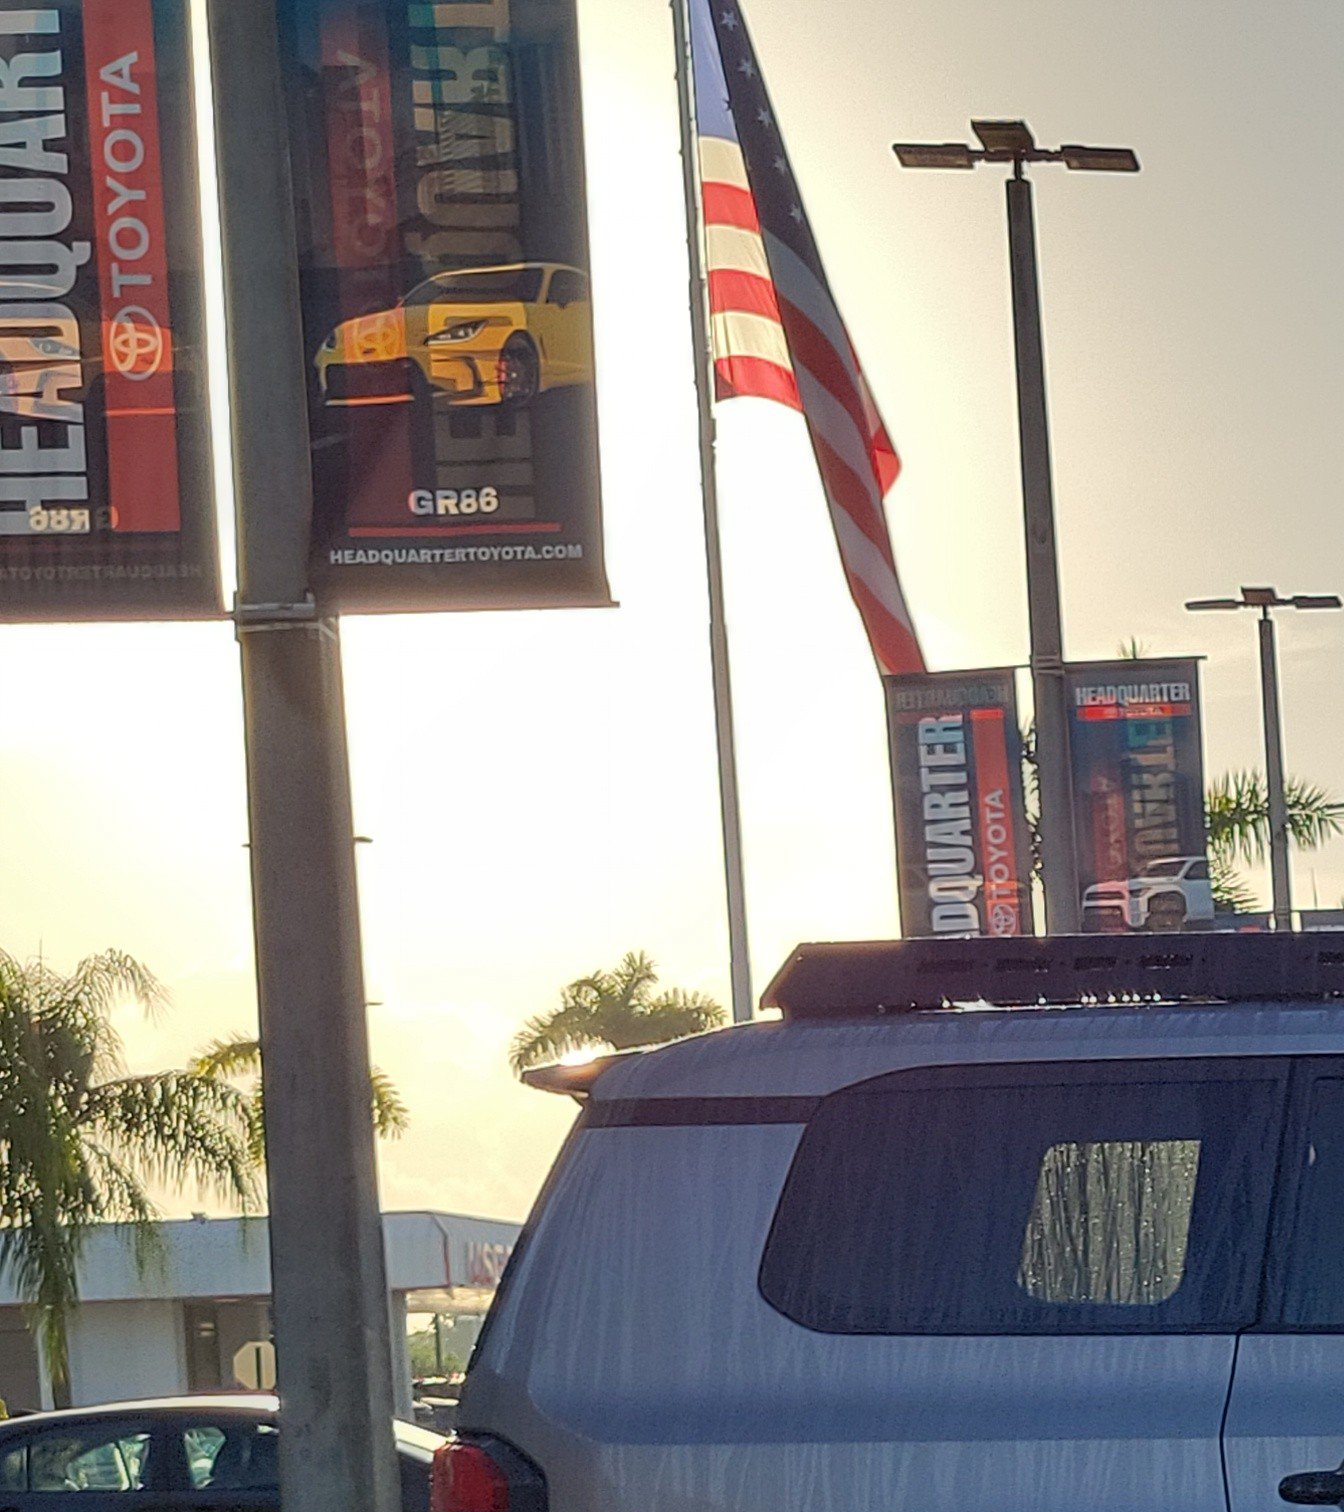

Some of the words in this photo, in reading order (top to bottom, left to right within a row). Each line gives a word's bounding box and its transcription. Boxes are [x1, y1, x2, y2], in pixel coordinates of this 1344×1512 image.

[99, 50, 153, 298] TOYOTA
[407, 487, 499, 516] GR86
[329, 544, 583, 566] HEADQUARTERTOYOTA.COM
[1075, 682, 1190, 707] HEADQUARTER
[984, 789, 1012, 899] TOYOTA
